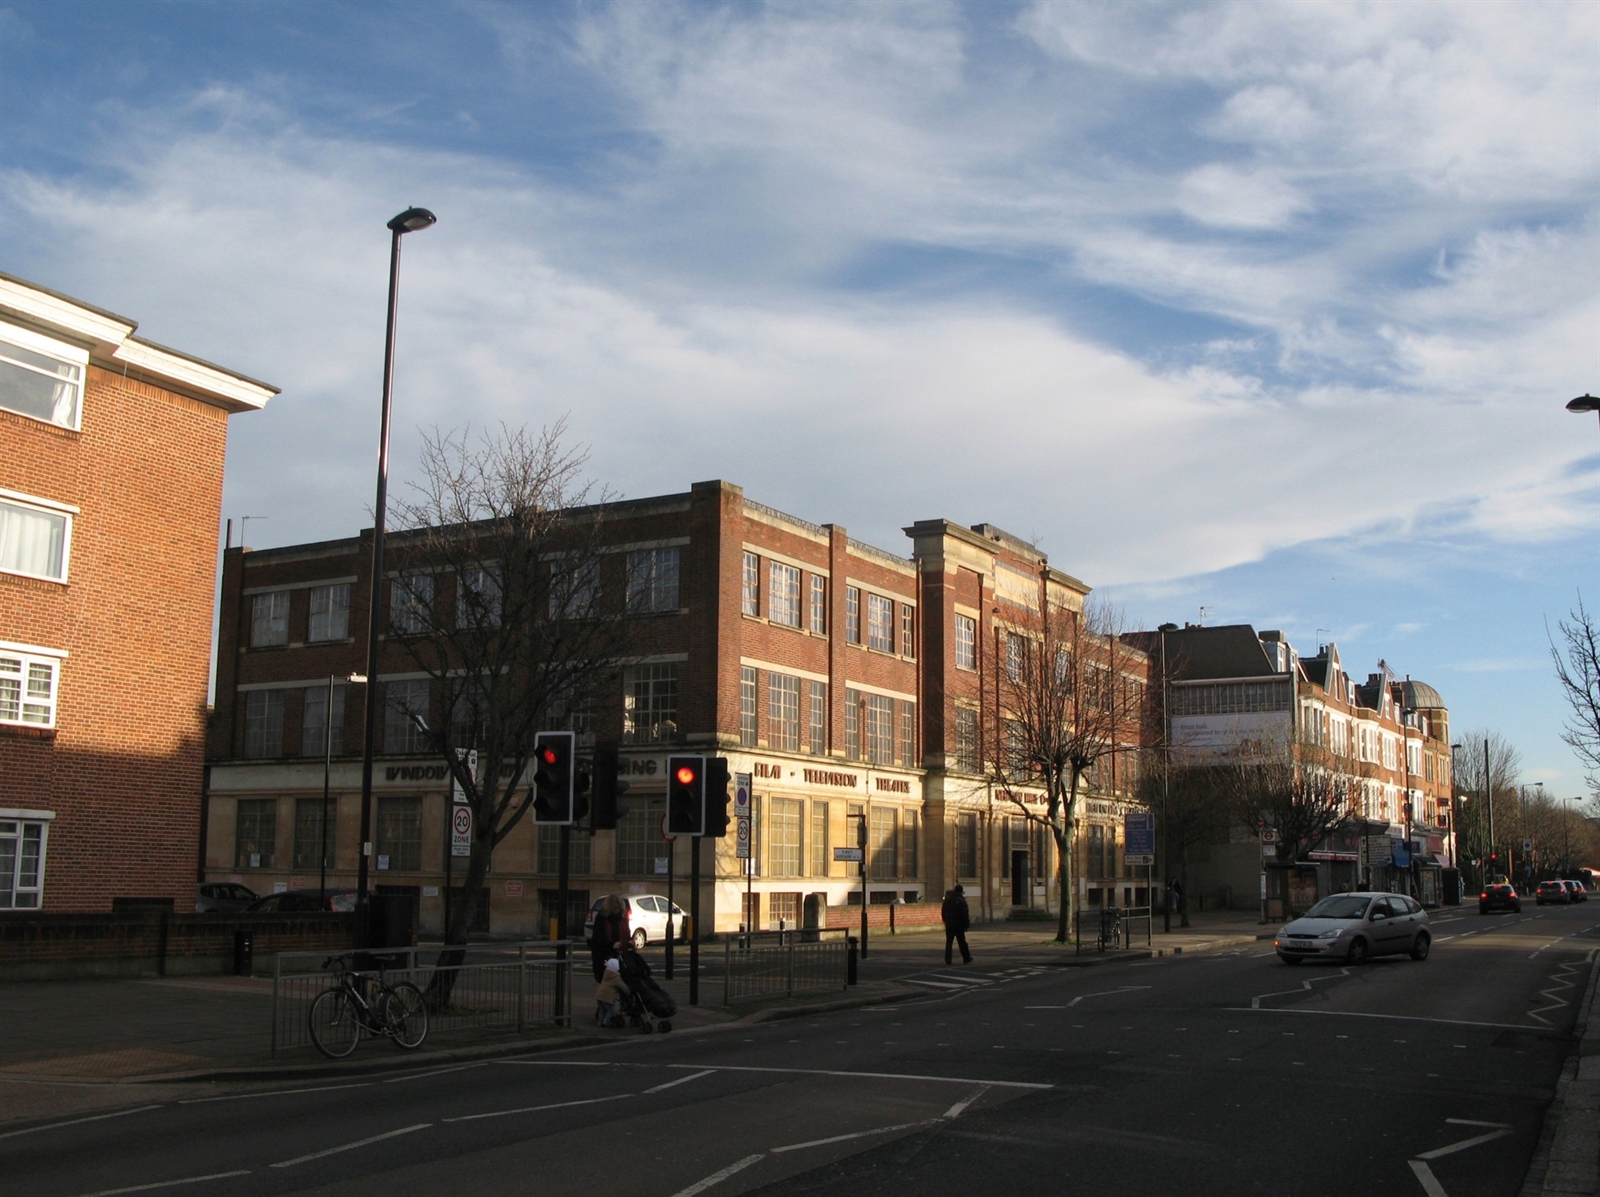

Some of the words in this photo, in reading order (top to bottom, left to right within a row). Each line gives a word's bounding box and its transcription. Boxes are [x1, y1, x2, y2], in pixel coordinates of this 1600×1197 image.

[385, 766, 451, 781] WINDOW
[755, 763, 781, 778] FILM
[804, 769, 857, 788] TELEVISION
[876, 778, 910, 793] THEATRE
[456, 816, 468, 827] 20
[453, 836, 470, 844] ZONE
